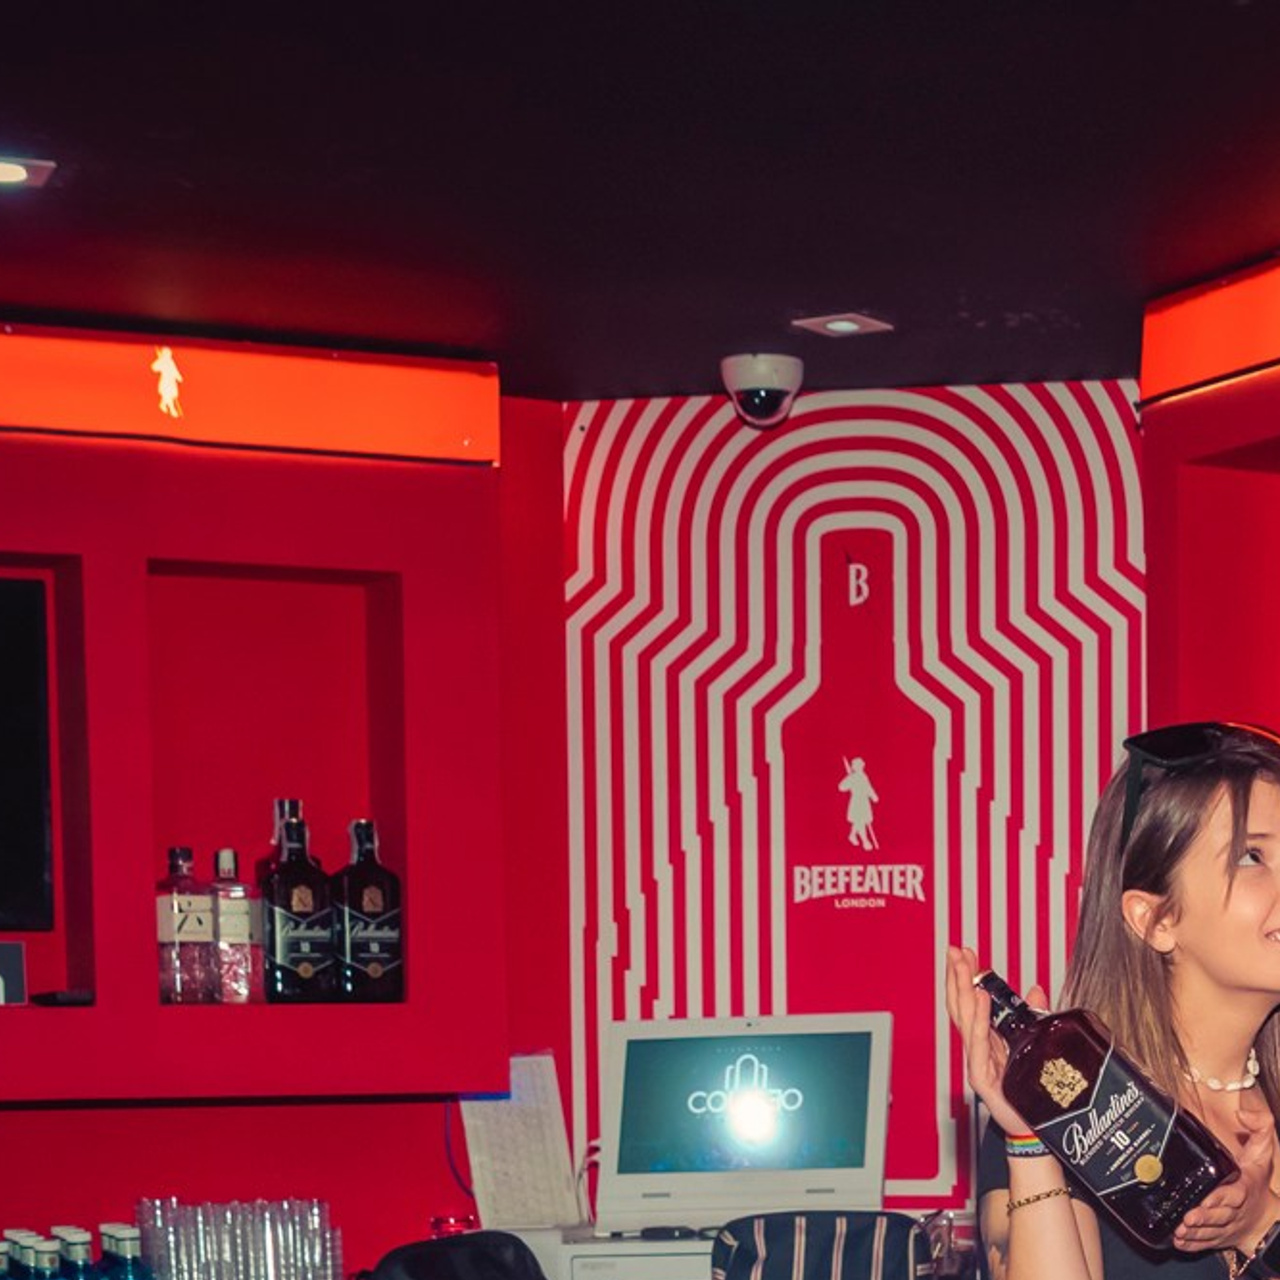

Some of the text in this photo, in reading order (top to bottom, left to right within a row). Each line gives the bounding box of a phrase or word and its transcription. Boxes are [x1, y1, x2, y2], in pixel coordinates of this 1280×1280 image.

[849, 563, 870, 606] B
[793, 864, 926, 903] BEEFEATER
[834, 897, 886, 908] LONDON
[1062, 1081, 1139, 1165] Ballantine's
[1110, 1130, 1131, 1151] 10
